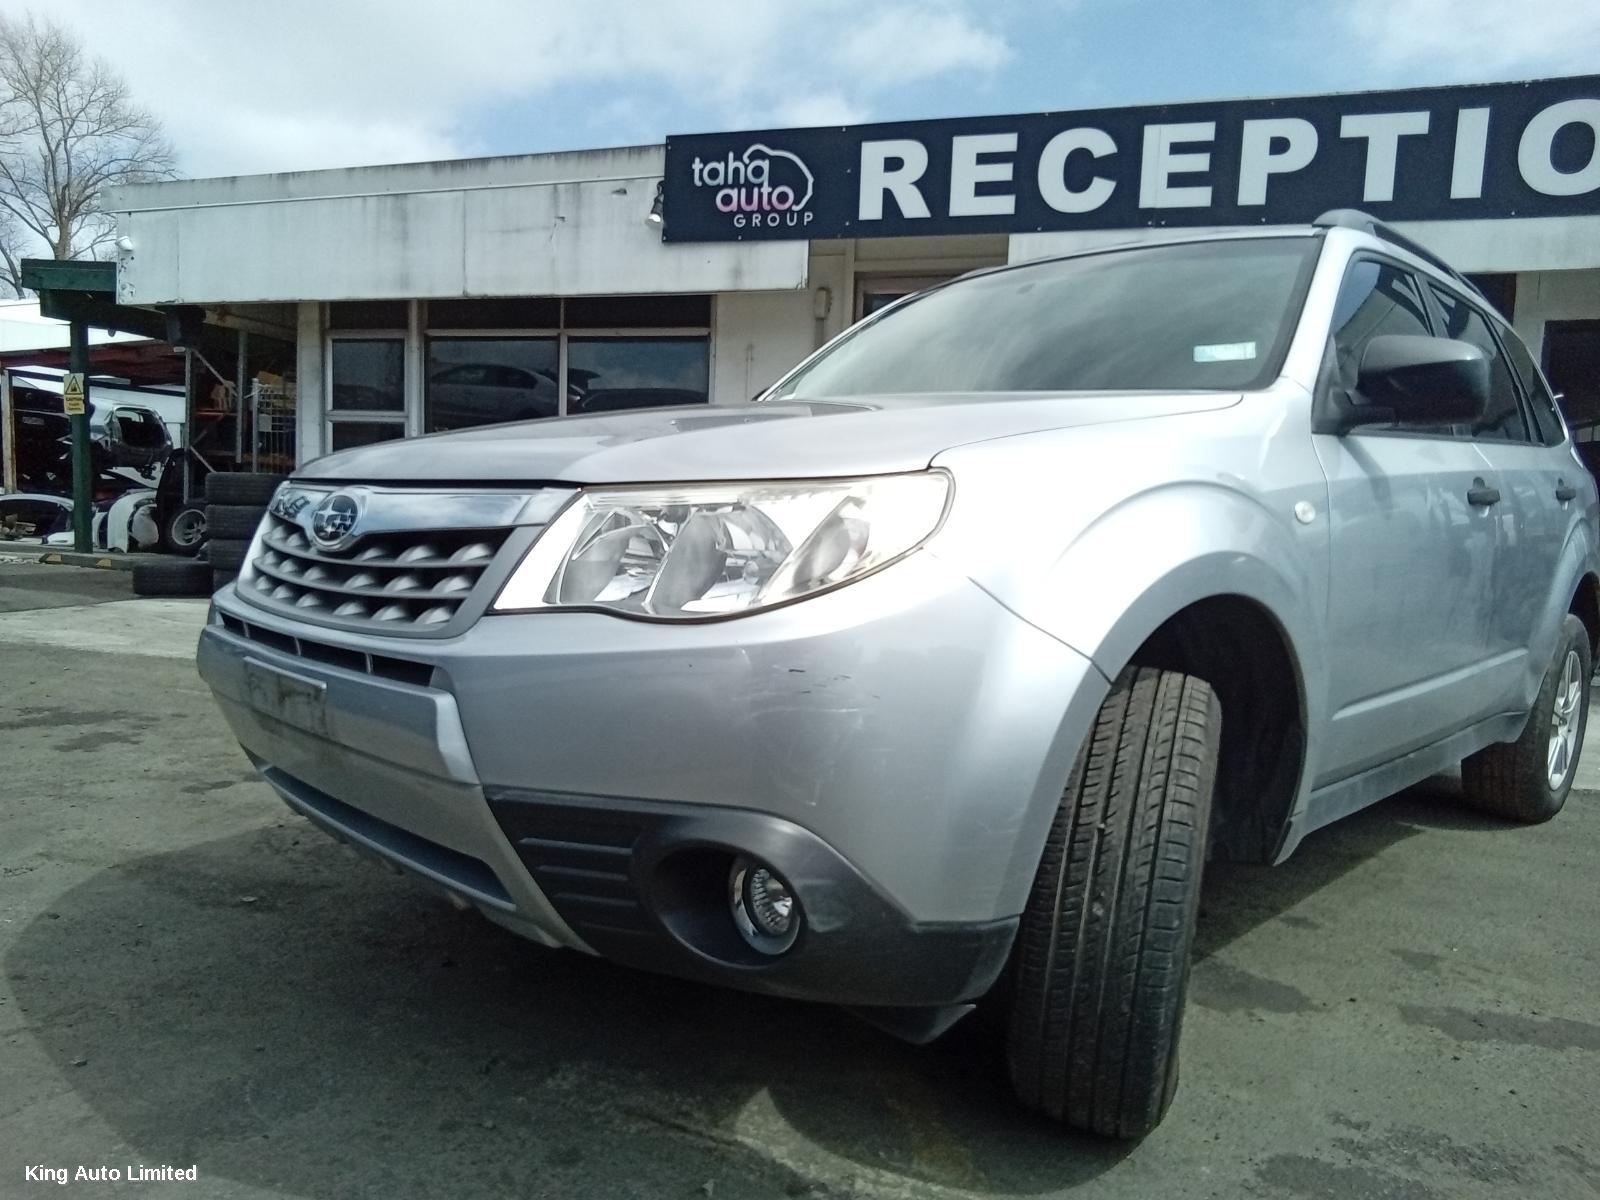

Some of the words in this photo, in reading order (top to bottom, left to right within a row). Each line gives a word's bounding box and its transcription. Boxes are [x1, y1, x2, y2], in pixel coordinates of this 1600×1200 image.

[691, 151, 770, 187] taha
[858, 98, 1600, 221] RECEPTIO
[715, 185, 795, 213] auto
[733, 211, 814, 228] GROUP
